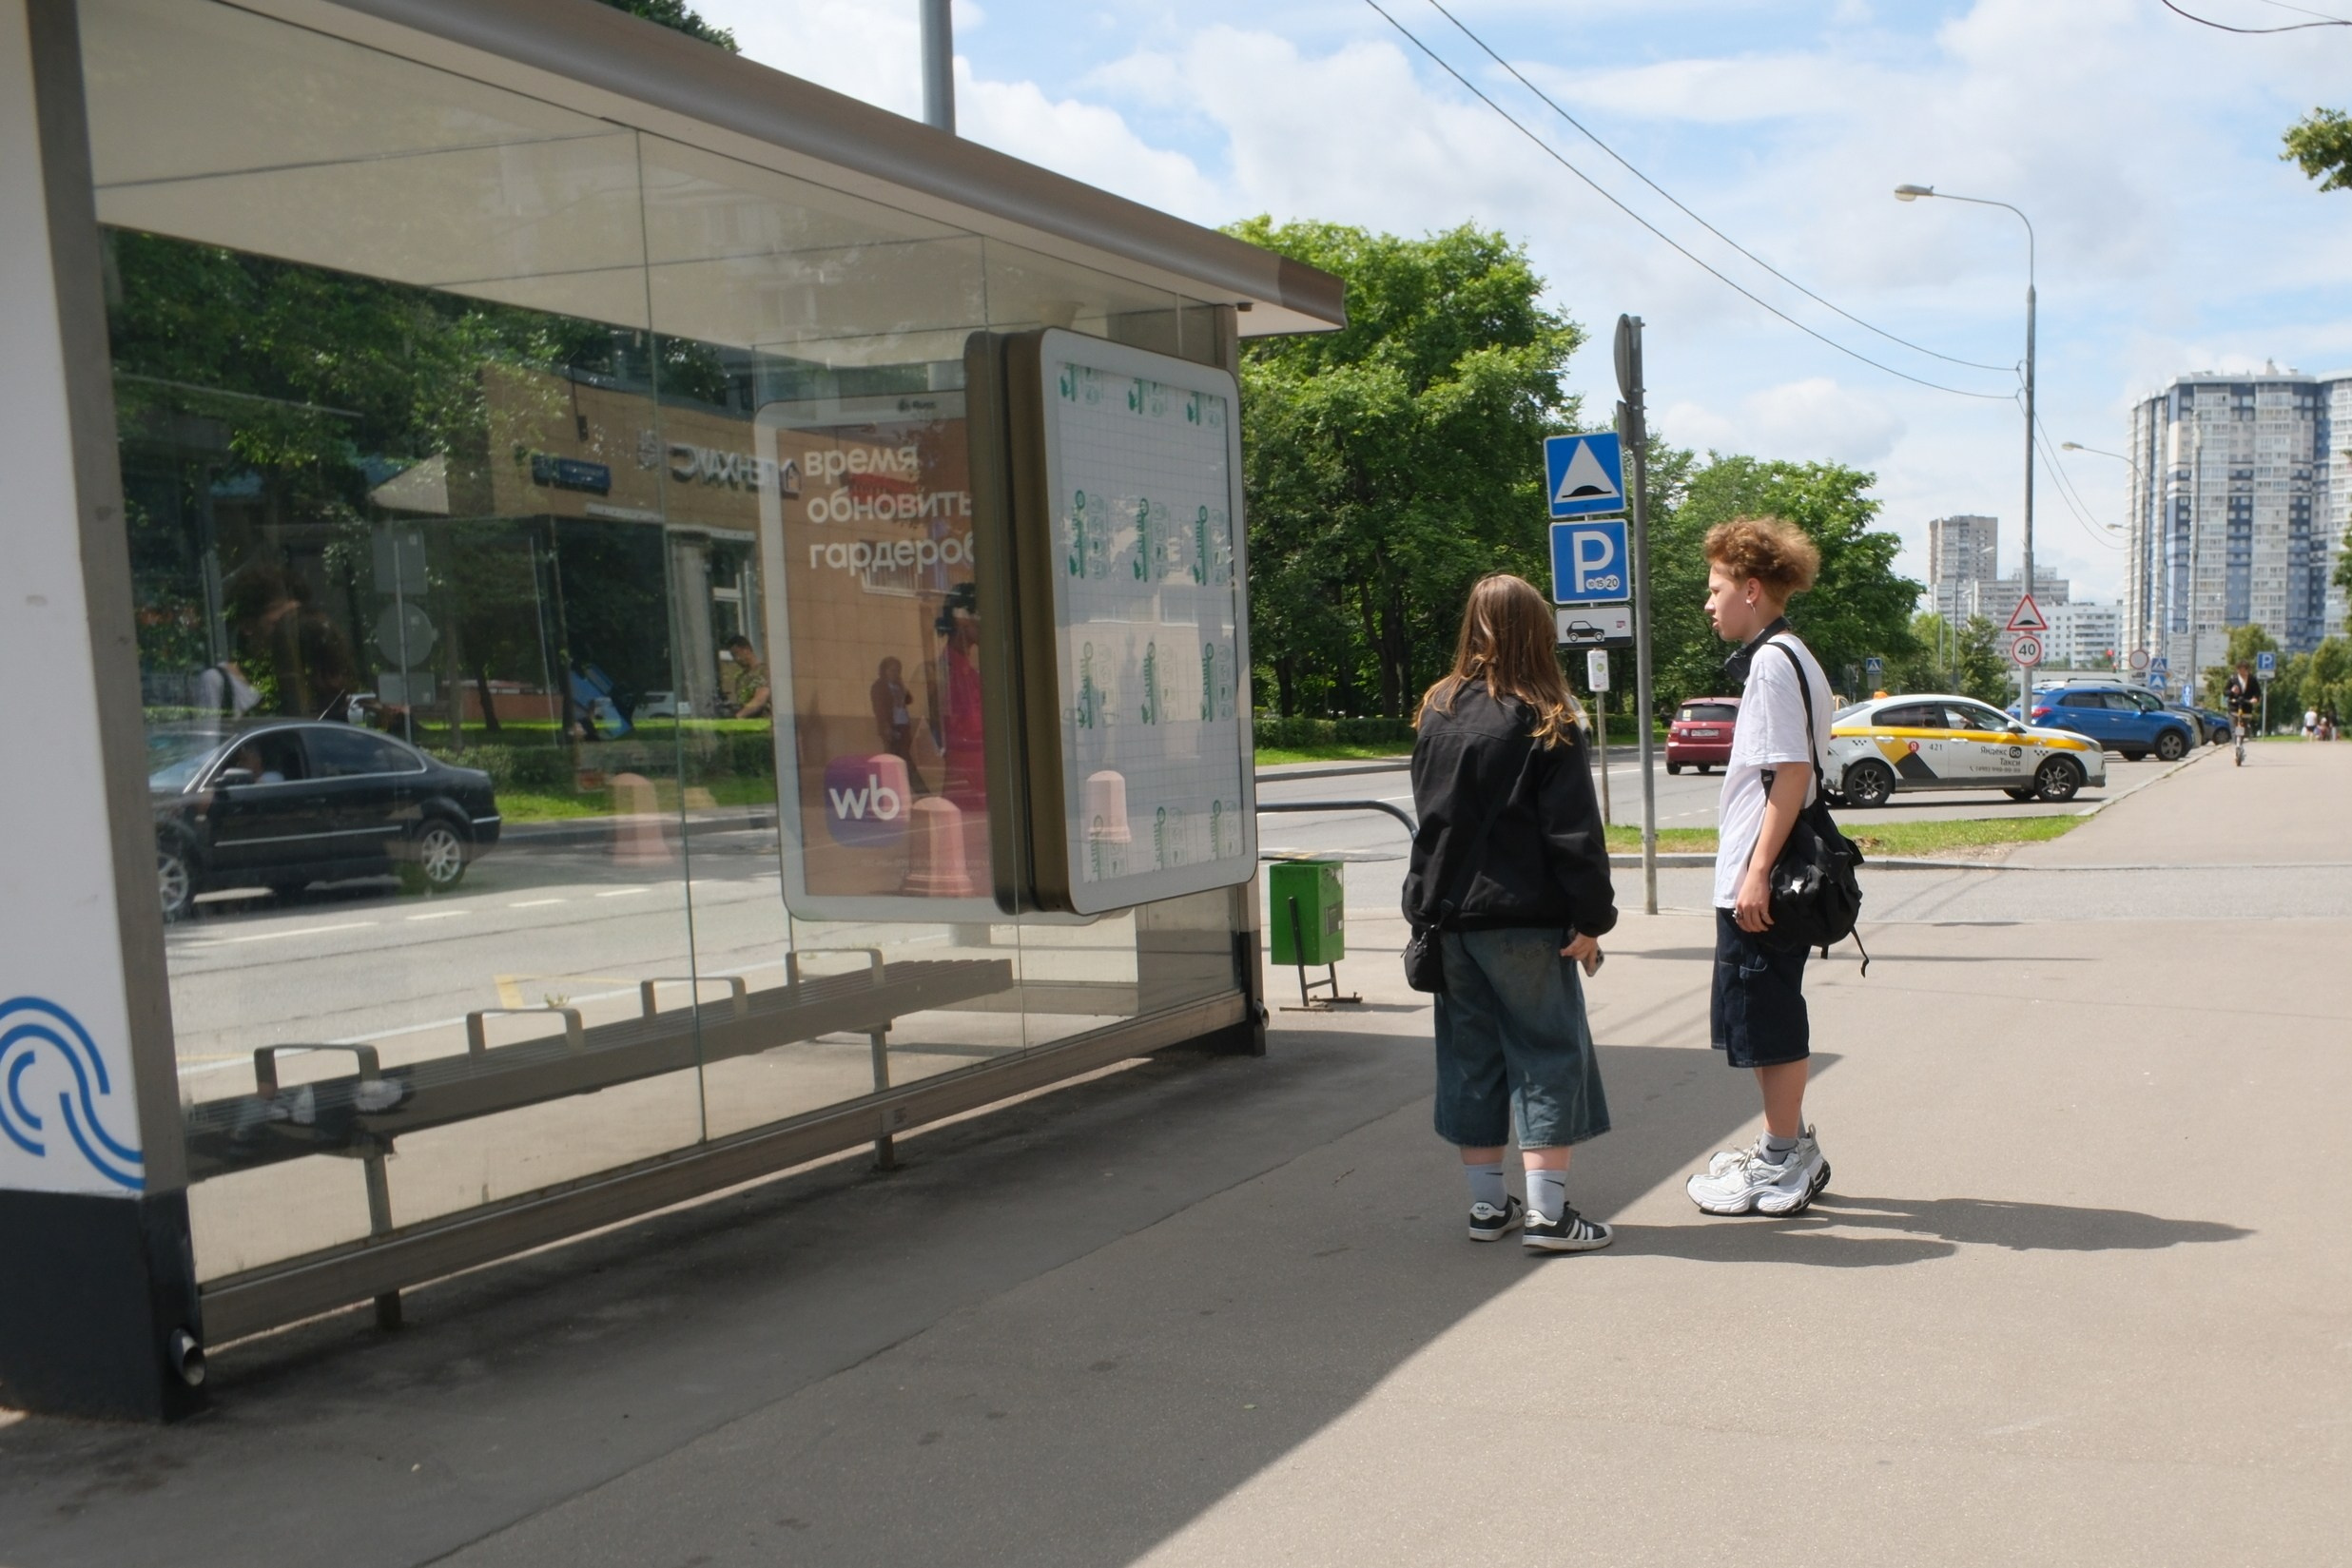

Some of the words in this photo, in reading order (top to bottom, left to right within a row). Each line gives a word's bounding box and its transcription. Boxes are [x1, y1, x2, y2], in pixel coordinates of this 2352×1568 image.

[804, 445, 919, 484] время
[1572, 531, 1615, 593] P
[1606, 578, 1618, 588] 20
[2018, 644, 2036, 656] 40
[2262, 654, 2273, 668] P
[1929, 743, 1943, 751] 421
[1980, 745, 2008, 756] Яндекс
[2010, 747, 2021, 758] Go
[2000, 758, 2021, 766] Такси
[827, 773, 900, 821] wb
